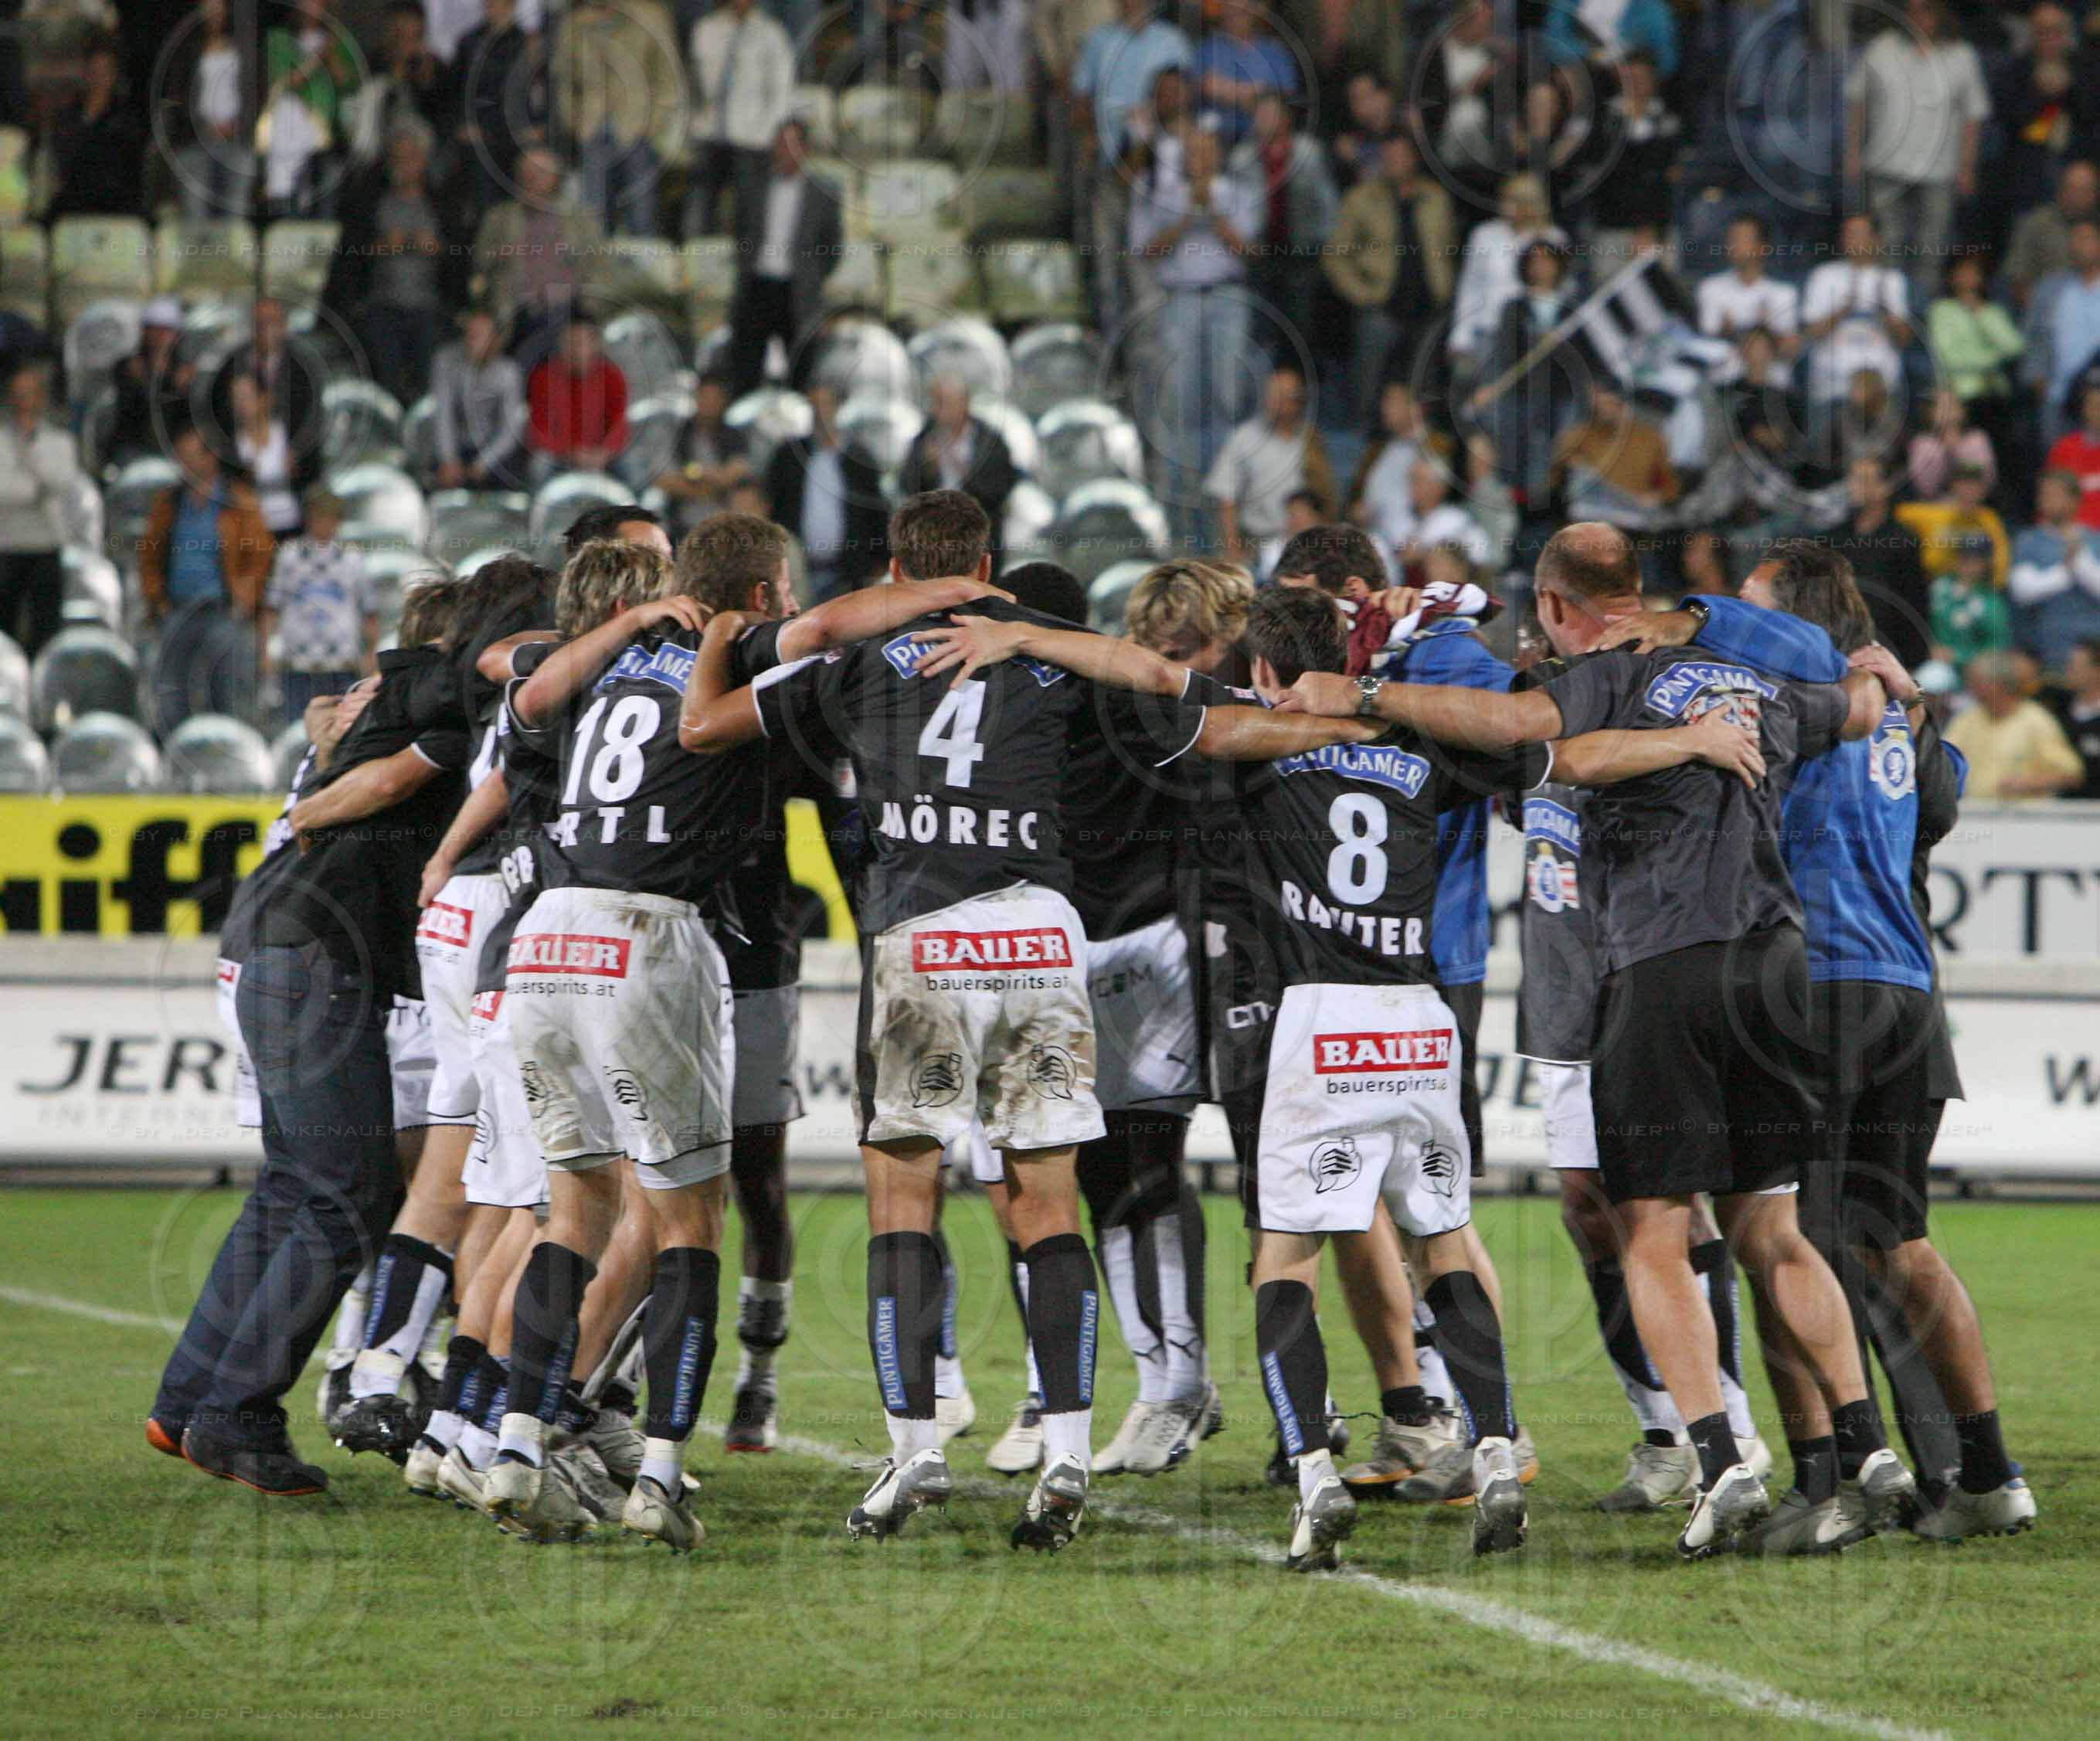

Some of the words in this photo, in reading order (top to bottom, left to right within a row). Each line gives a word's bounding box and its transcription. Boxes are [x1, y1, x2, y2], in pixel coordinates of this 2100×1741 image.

[562, 695, 661, 803] 18
[918, 679, 987, 788] 4
[878, 794, 1038, 850] MÖREC
[1327, 792, 1388, 905] 8
[920, 935, 1069, 964] BAUER
[1320, 1036, 1450, 1067] BAUER
[878, 1300, 903, 1405] PUNTIGAMER
[1080, 1294, 1097, 1399] PUNTIGAMER
[1265, 1355, 1303, 1451] PUNTIGAMER
